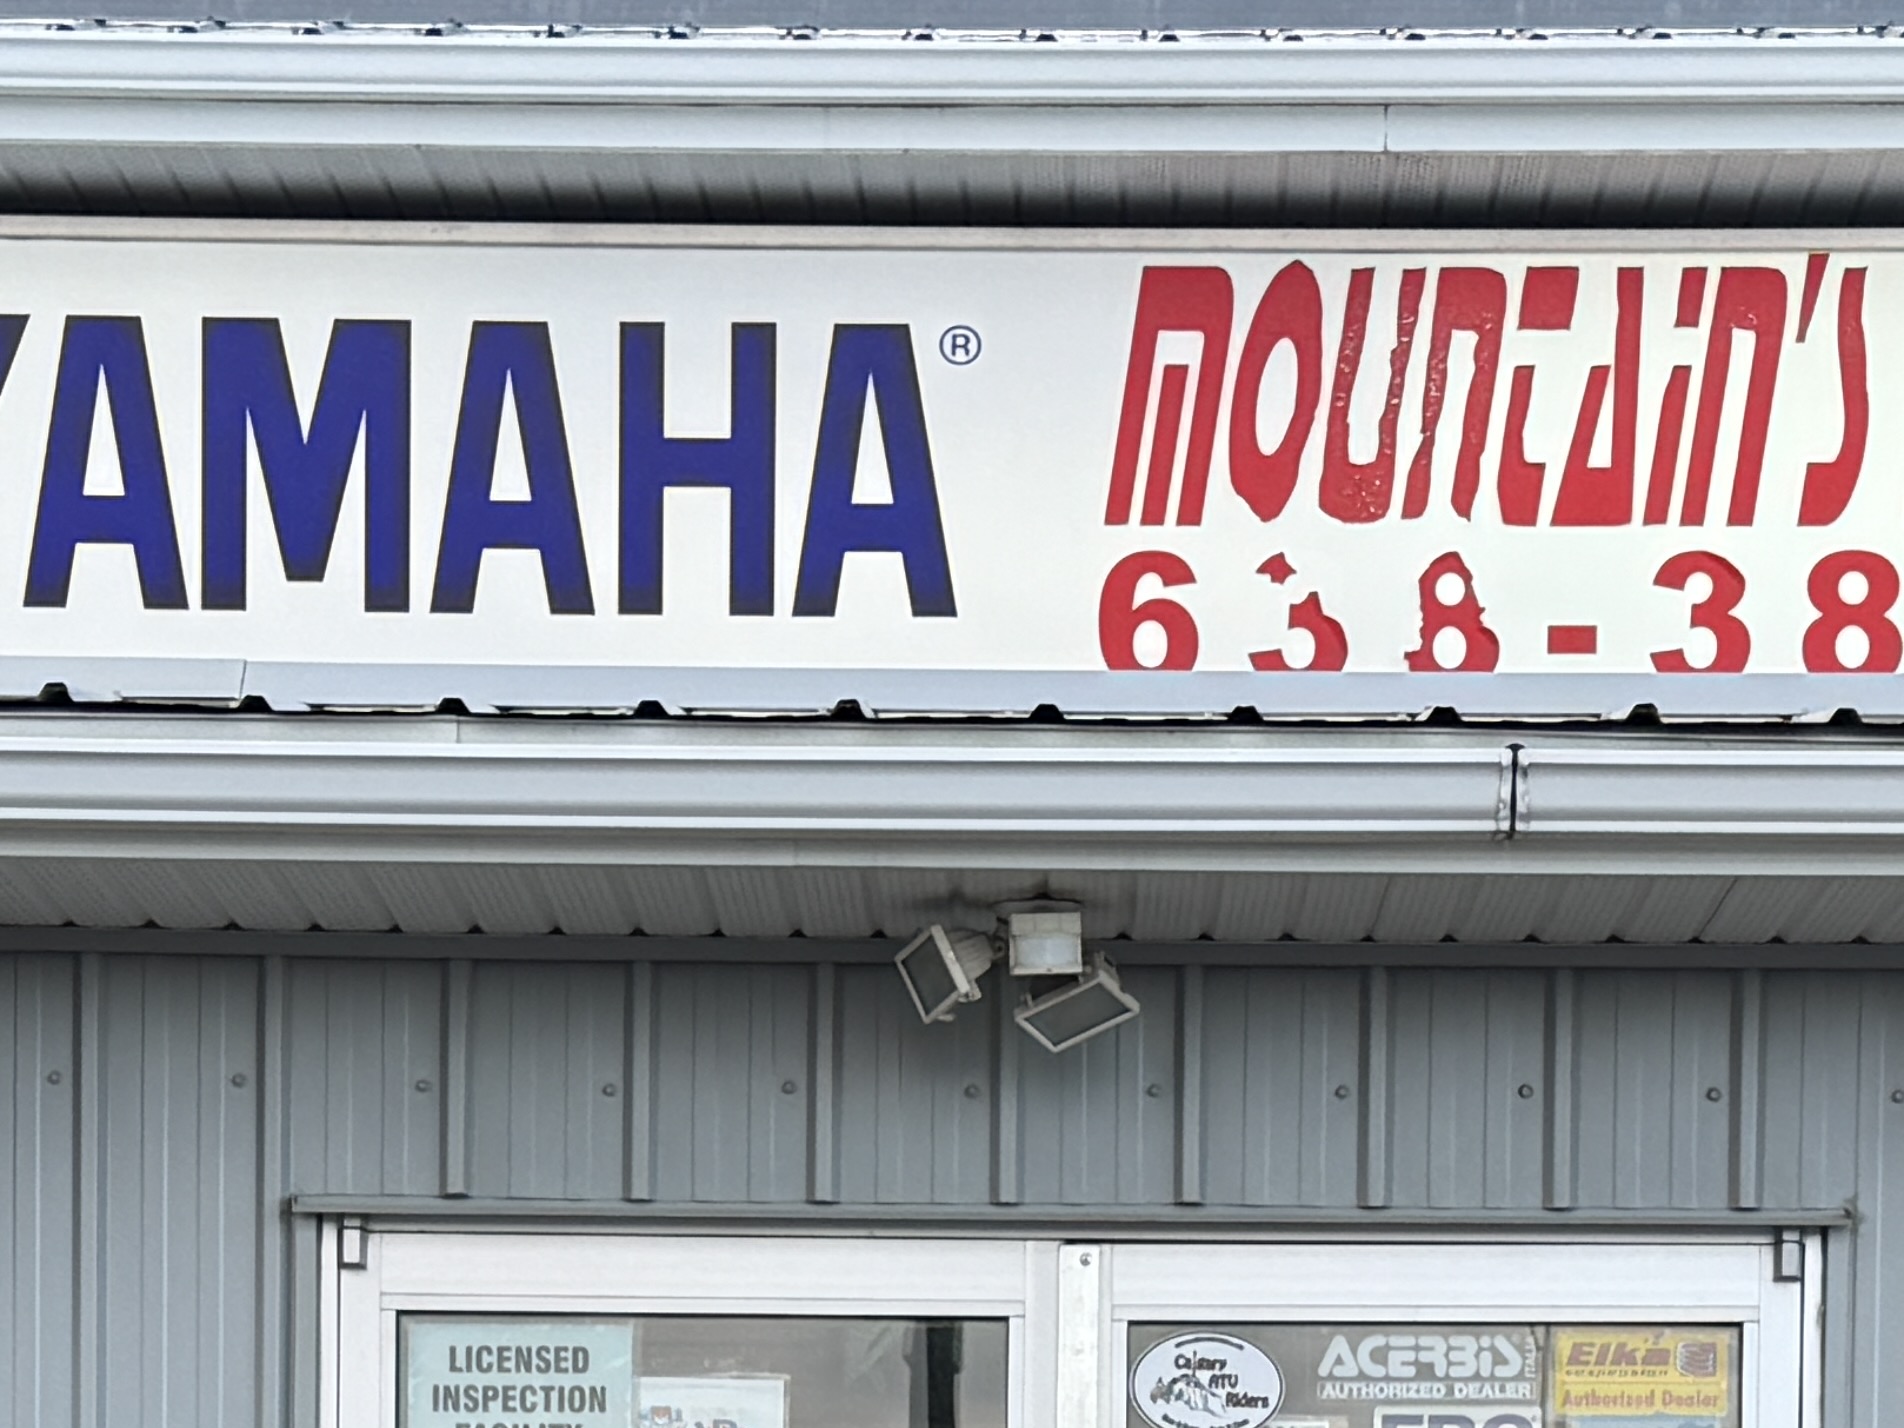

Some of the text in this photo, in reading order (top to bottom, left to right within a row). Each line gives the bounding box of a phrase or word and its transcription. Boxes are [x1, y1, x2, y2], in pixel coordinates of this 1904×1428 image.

[1104, 252, 1870, 526] MOUNTAIN'S
[449, 1345, 590, 1374] LICENSED
[432, 1384, 608, 1413] INSPECTION
[1225, 1391, 1270, 1409] Riders
[1321, 1381, 1531, 1399] AUTHORIZED DEALER
[1563, 1389, 1720, 1409] Authorized Dealer
